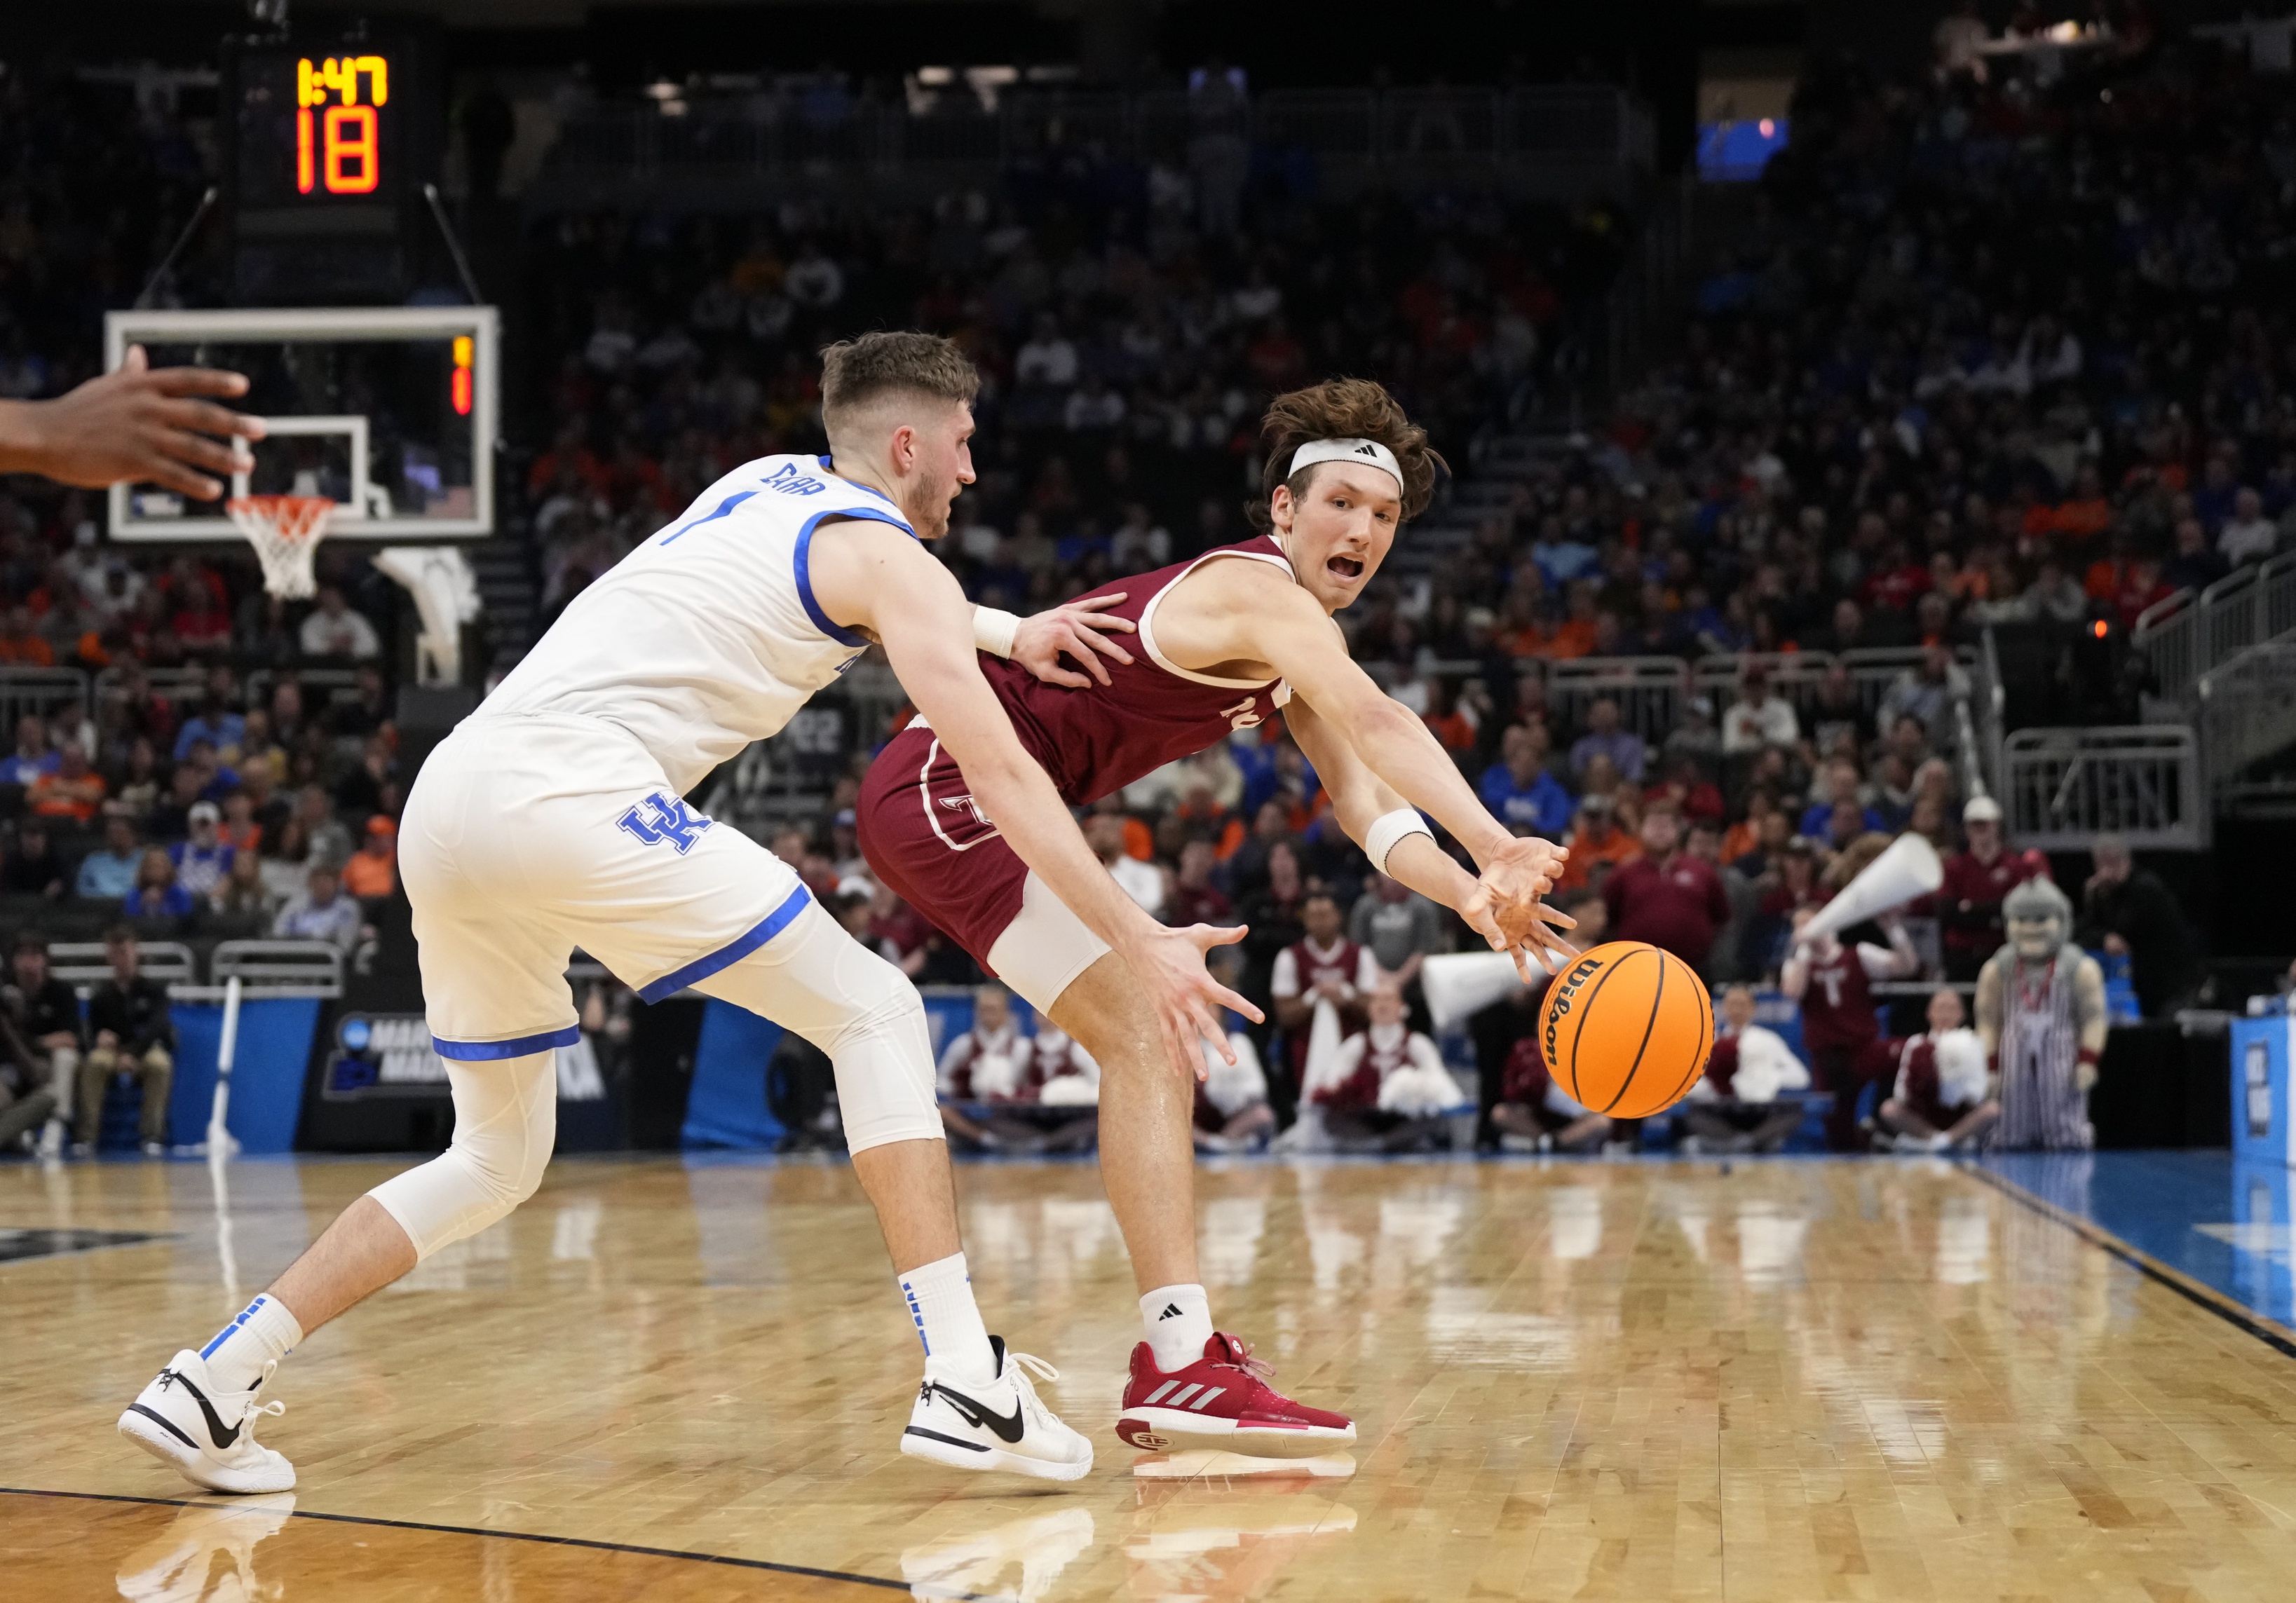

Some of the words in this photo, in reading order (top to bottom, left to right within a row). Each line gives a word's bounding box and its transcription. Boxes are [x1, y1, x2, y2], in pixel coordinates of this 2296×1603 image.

[298, 55, 388, 108] 1:47
[297, 105, 379, 195] 18
[759, 463, 826, 496] CARR
[659, 491, 761, 546] 1
[616, 792, 715, 856] UK
[1546, 959, 1604, 1066] Wilson
